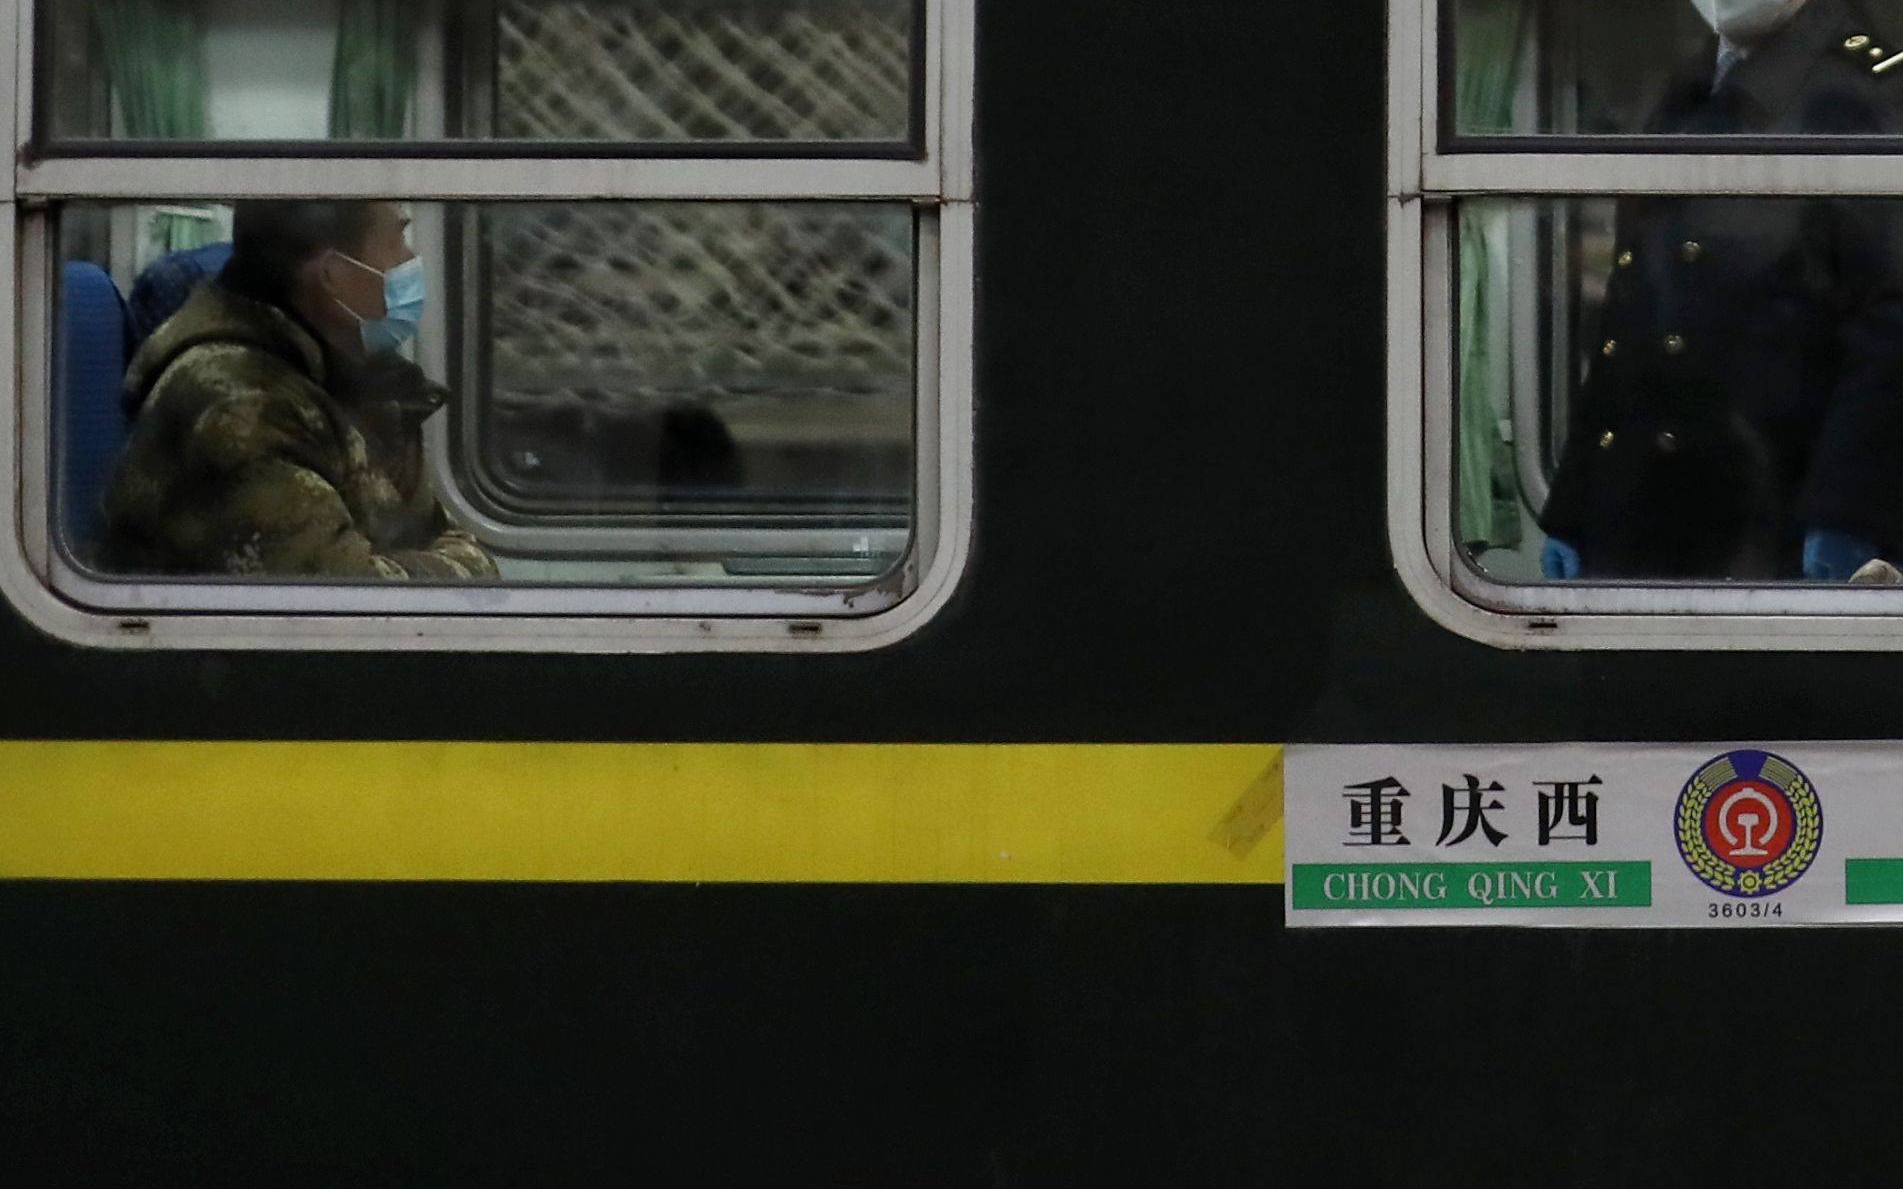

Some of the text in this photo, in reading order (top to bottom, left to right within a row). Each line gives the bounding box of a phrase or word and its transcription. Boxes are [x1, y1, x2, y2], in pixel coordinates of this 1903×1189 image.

[1341, 773, 1604, 848] 重庆西
[1323, 870, 1619, 906] CHONG QING XI
[1708, 902, 1784, 919] 3603/4
